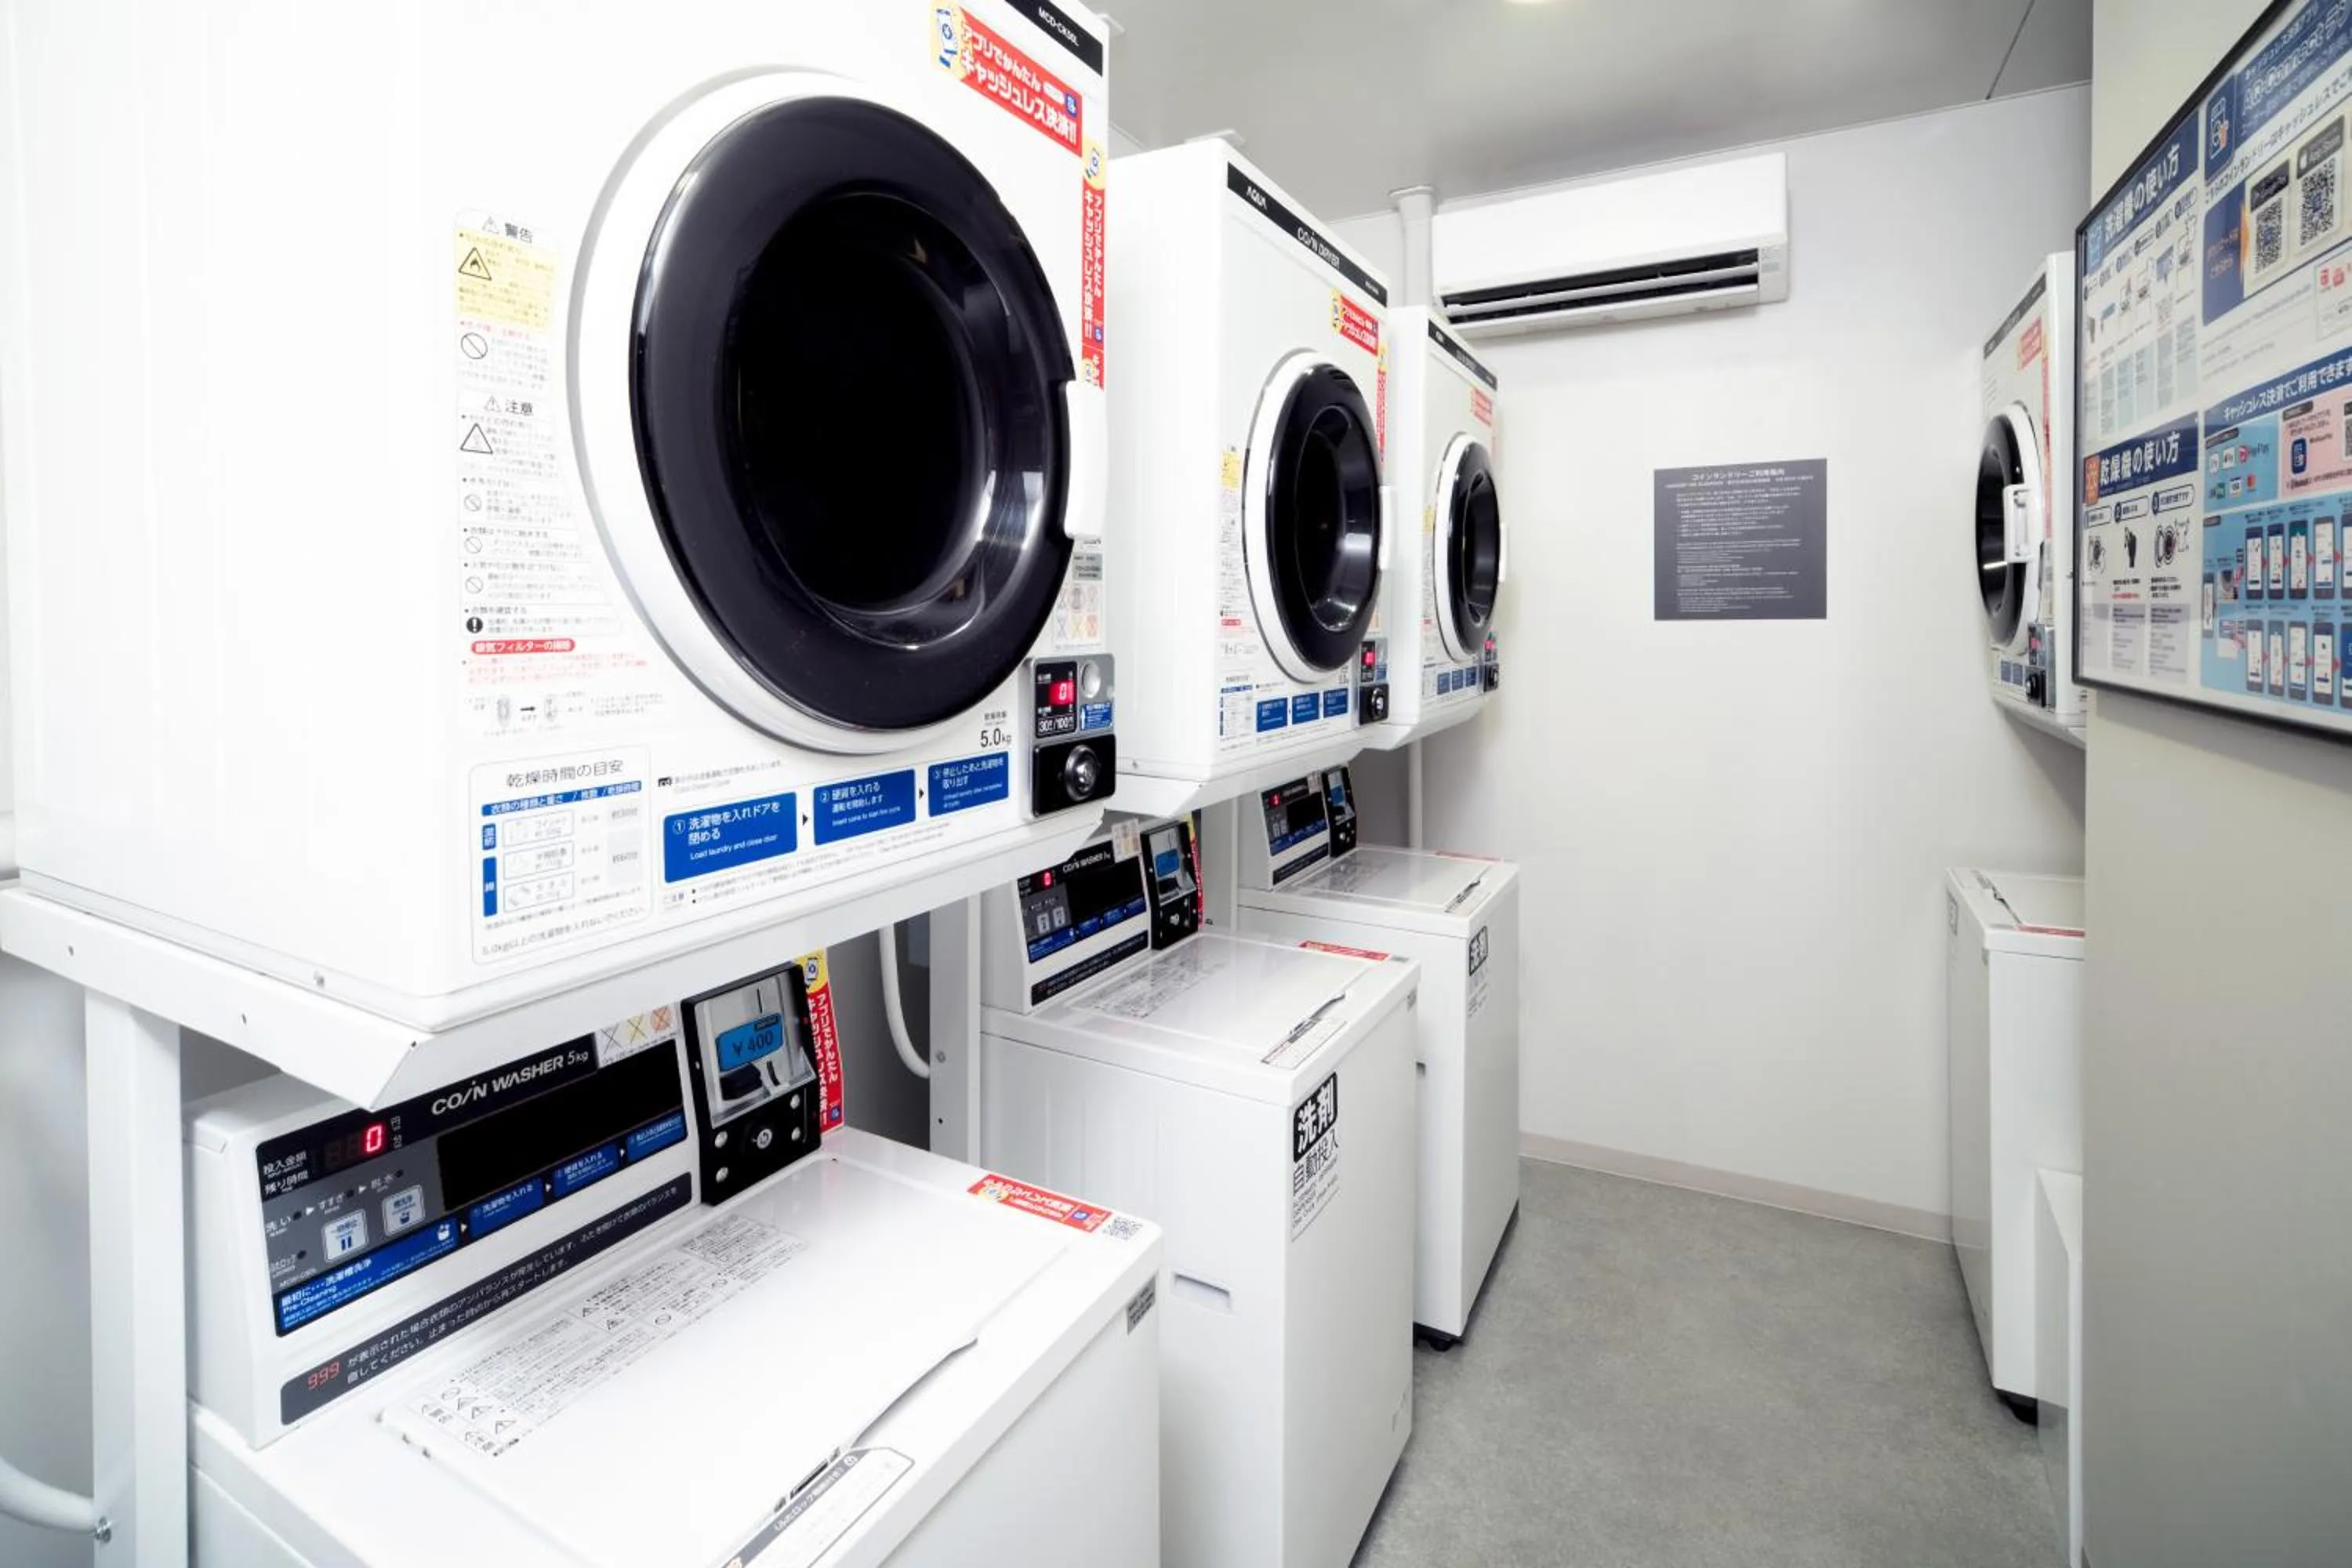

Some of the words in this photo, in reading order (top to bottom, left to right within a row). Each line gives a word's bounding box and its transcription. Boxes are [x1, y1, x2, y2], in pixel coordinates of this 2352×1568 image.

[961, 21, 1043, 93] アプリでかんたん
[506, 760, 623, 787] 乾燥時間の目安
[688, 801, 781, 830] 洗濯物を入れドアを
[688, 828, 721, 846] 閉める
[690, 851, 708, 861] Load
[709, 844, 733, 856] laundry
[734, 840, 746, 851] and
[746, 837, 763, 848] close
[764, 833, 779, 844] door
[432, 1079, 488, 1116] COIN
[492, 1054, 564, 1093] WASHER
[567, 1050, 589, 1065] 5kg
[1298, 1078, 1334, 1153] 洗剤
[365, 1124, 383, 1152] 0
[263, 1150, 307, 1175] 投入金額
[264, 1171, 308, 1194] 残り時間
[283, 1286, 337, 1314] Pre-Cleaning
